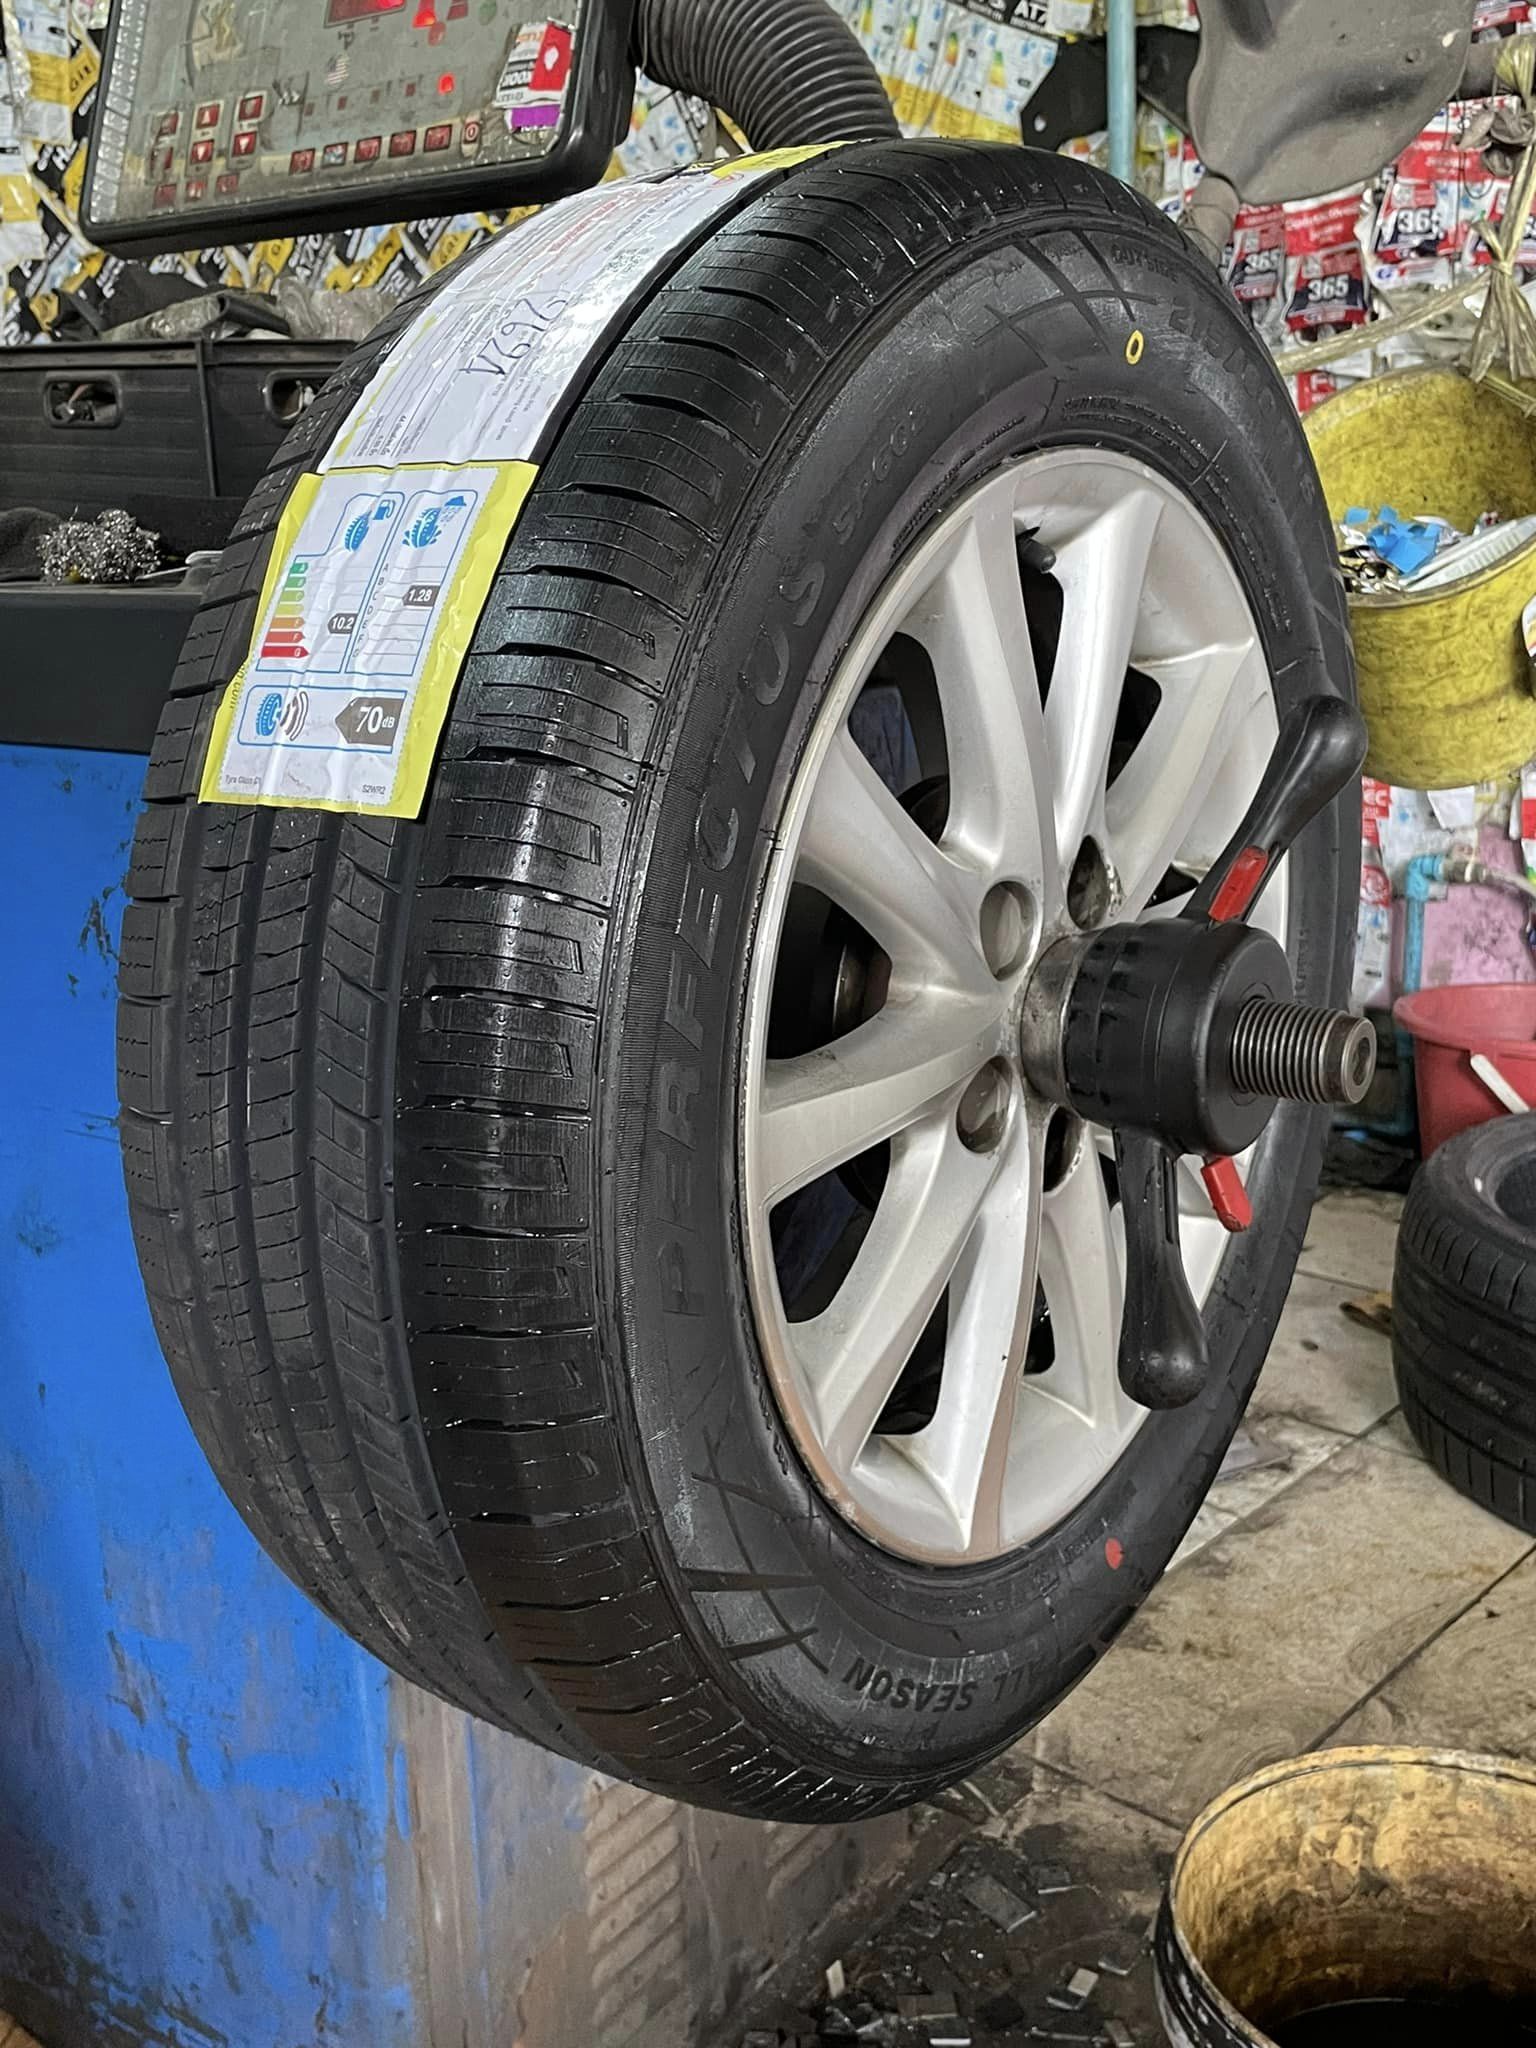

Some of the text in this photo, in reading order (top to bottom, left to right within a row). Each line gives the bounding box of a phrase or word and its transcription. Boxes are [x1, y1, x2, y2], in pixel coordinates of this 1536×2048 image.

[1308, 274, 1349, 300] 365
[408, 589, 432, 602] 1.28
[332, 617, 354, 630] 10.2
[655, 560, 825, 1317] PERFECTUS
[842, 1656, 979, 1713] SEASON
